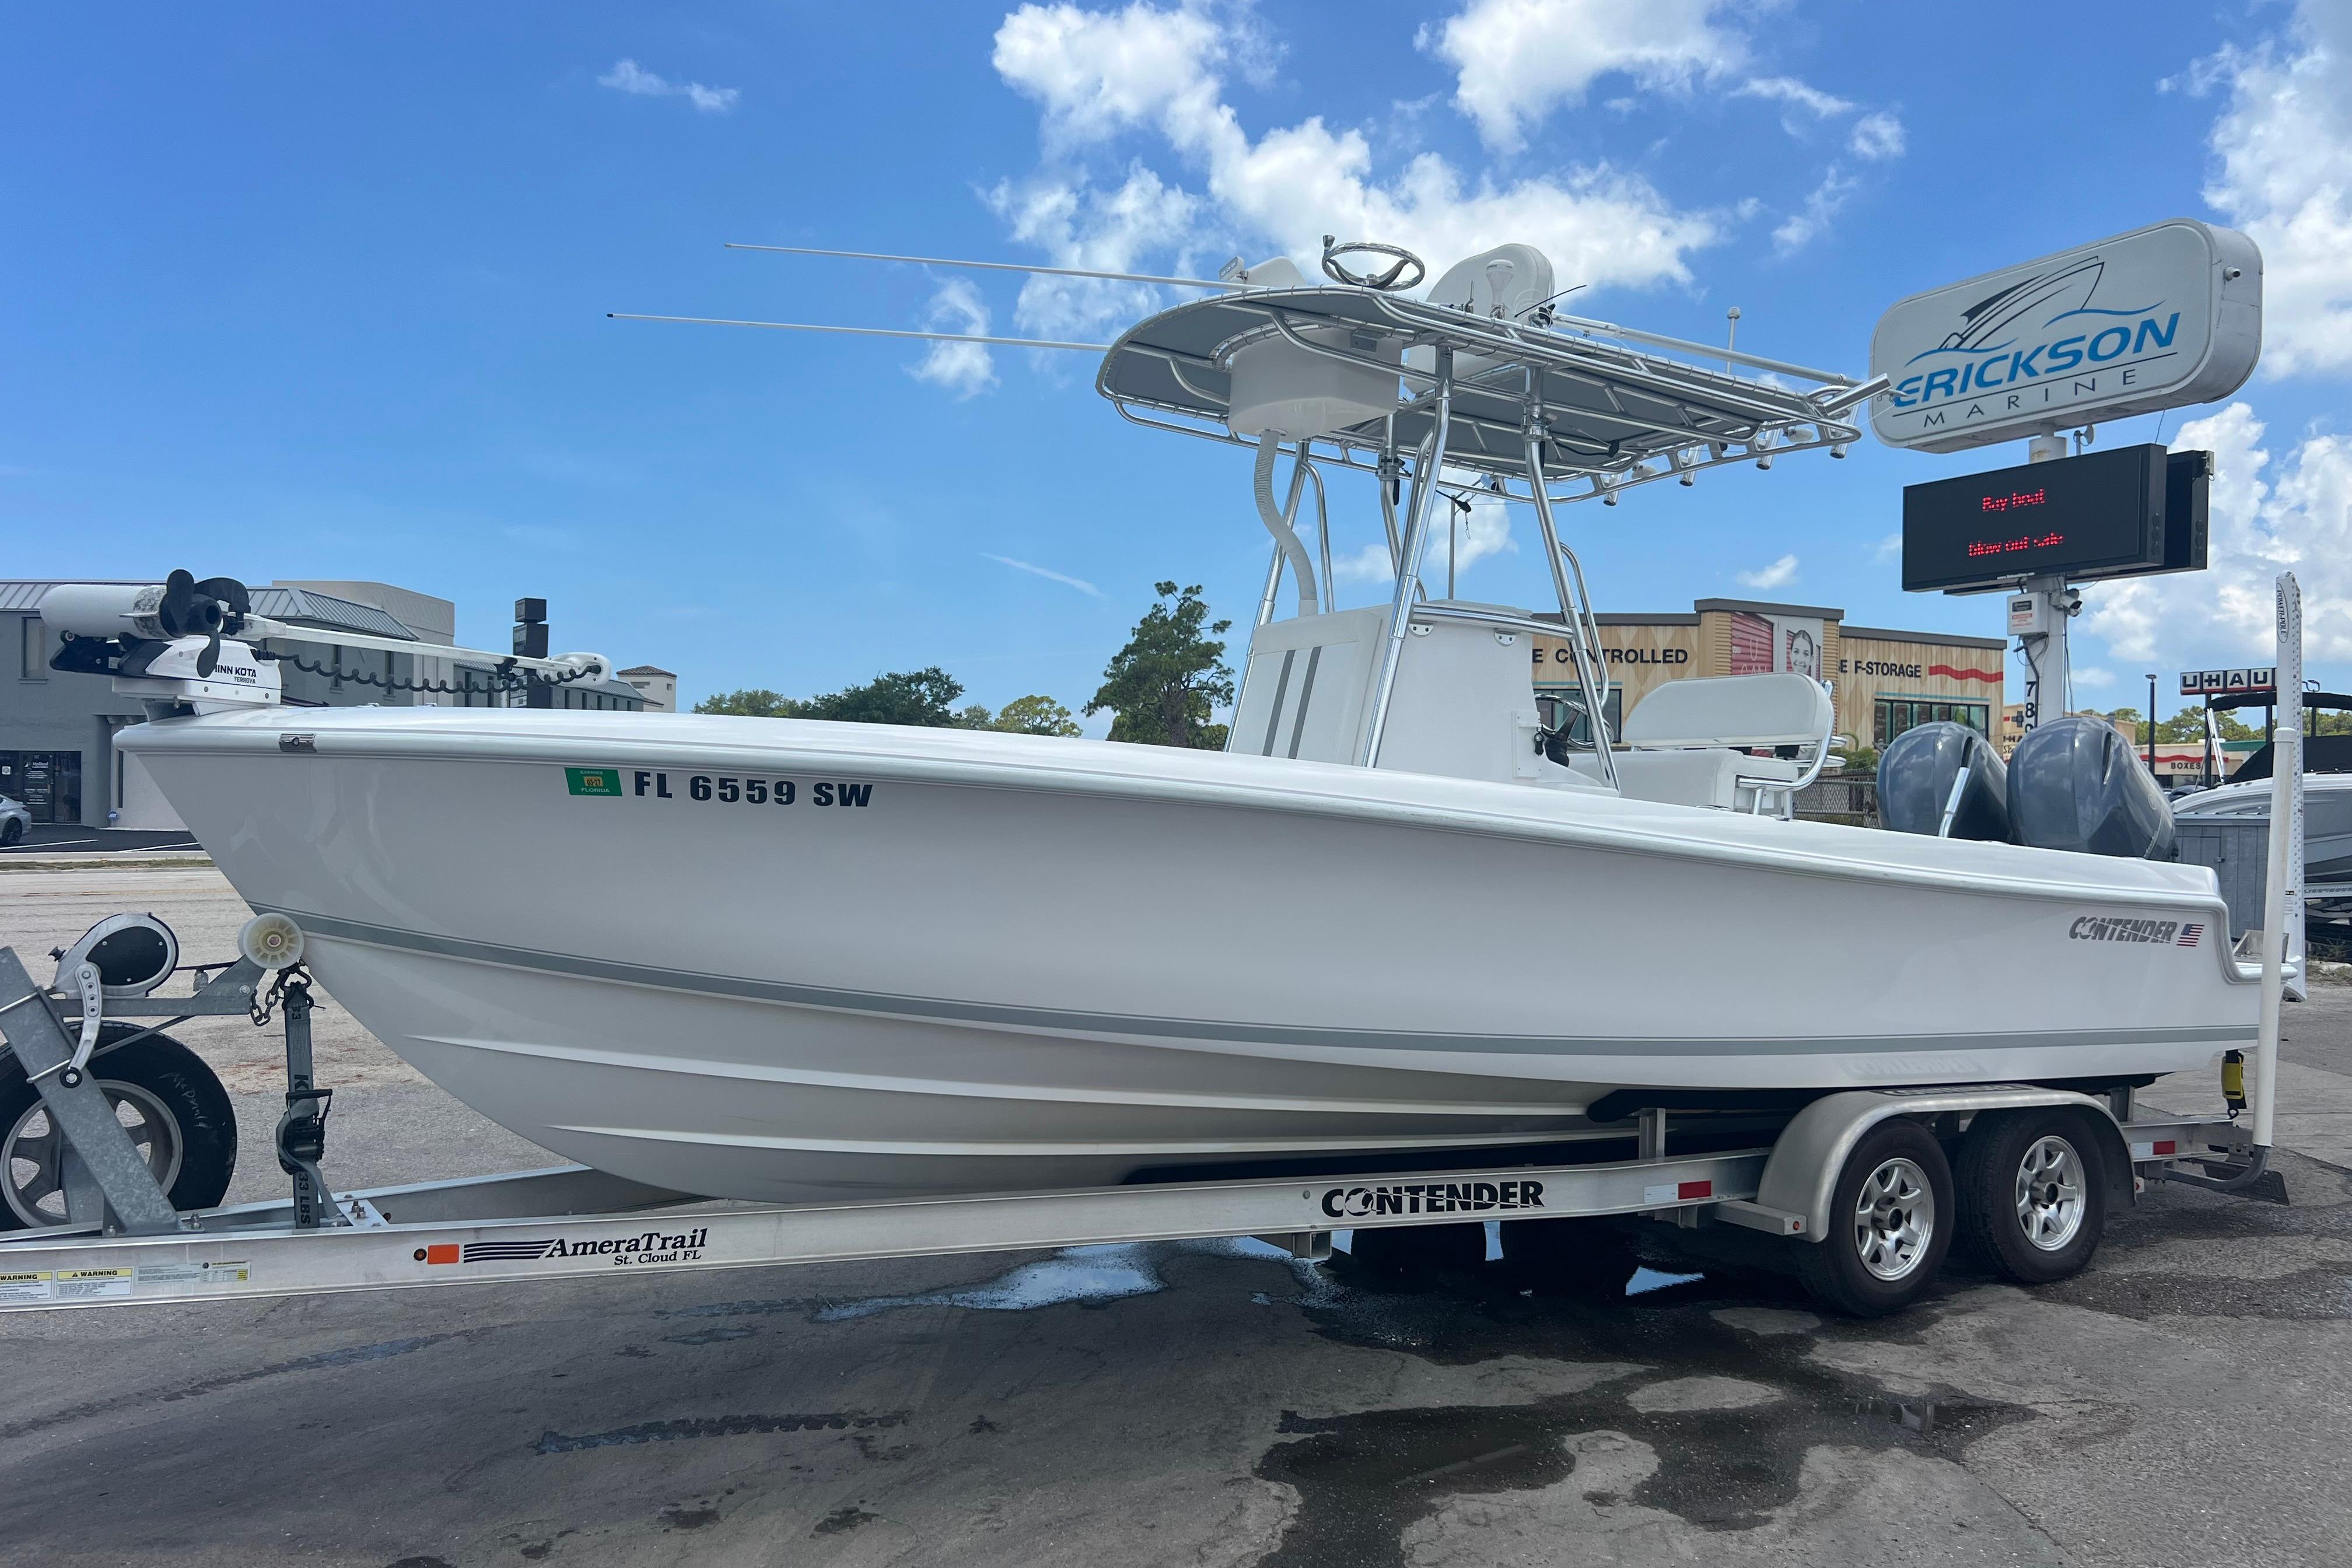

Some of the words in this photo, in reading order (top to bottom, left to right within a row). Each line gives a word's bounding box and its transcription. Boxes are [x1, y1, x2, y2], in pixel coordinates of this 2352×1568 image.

[1894, 312, 2180, 408] ERICKSON
[1923, 369, 2136, 428] MARINE
[2005, 536, 2029, 552] out
[215, 664, 233, 675] INN
[235, 666, 257, 677] KOTA
[234, 676, 256, 684] TERROVA
[2171, 762, 2202, 770] BOXES
[634, 771, 673, 799] FL
[690, 775, 796, 805] 6559
[813, 782, 873, 807] SW
[2068, 916, 2178, 944] CONTENDER
[300, 1196, 311, 1224] LBS
[1321, 1180, 1545, 1217] CONTENDER
[545, 1227, 708, 1258] AmeraTrail
[614, 1255, 632, 1265] St.
[638, 1251, 677, 1264] Cloud
[682, 1250, 701, 1260] FL
